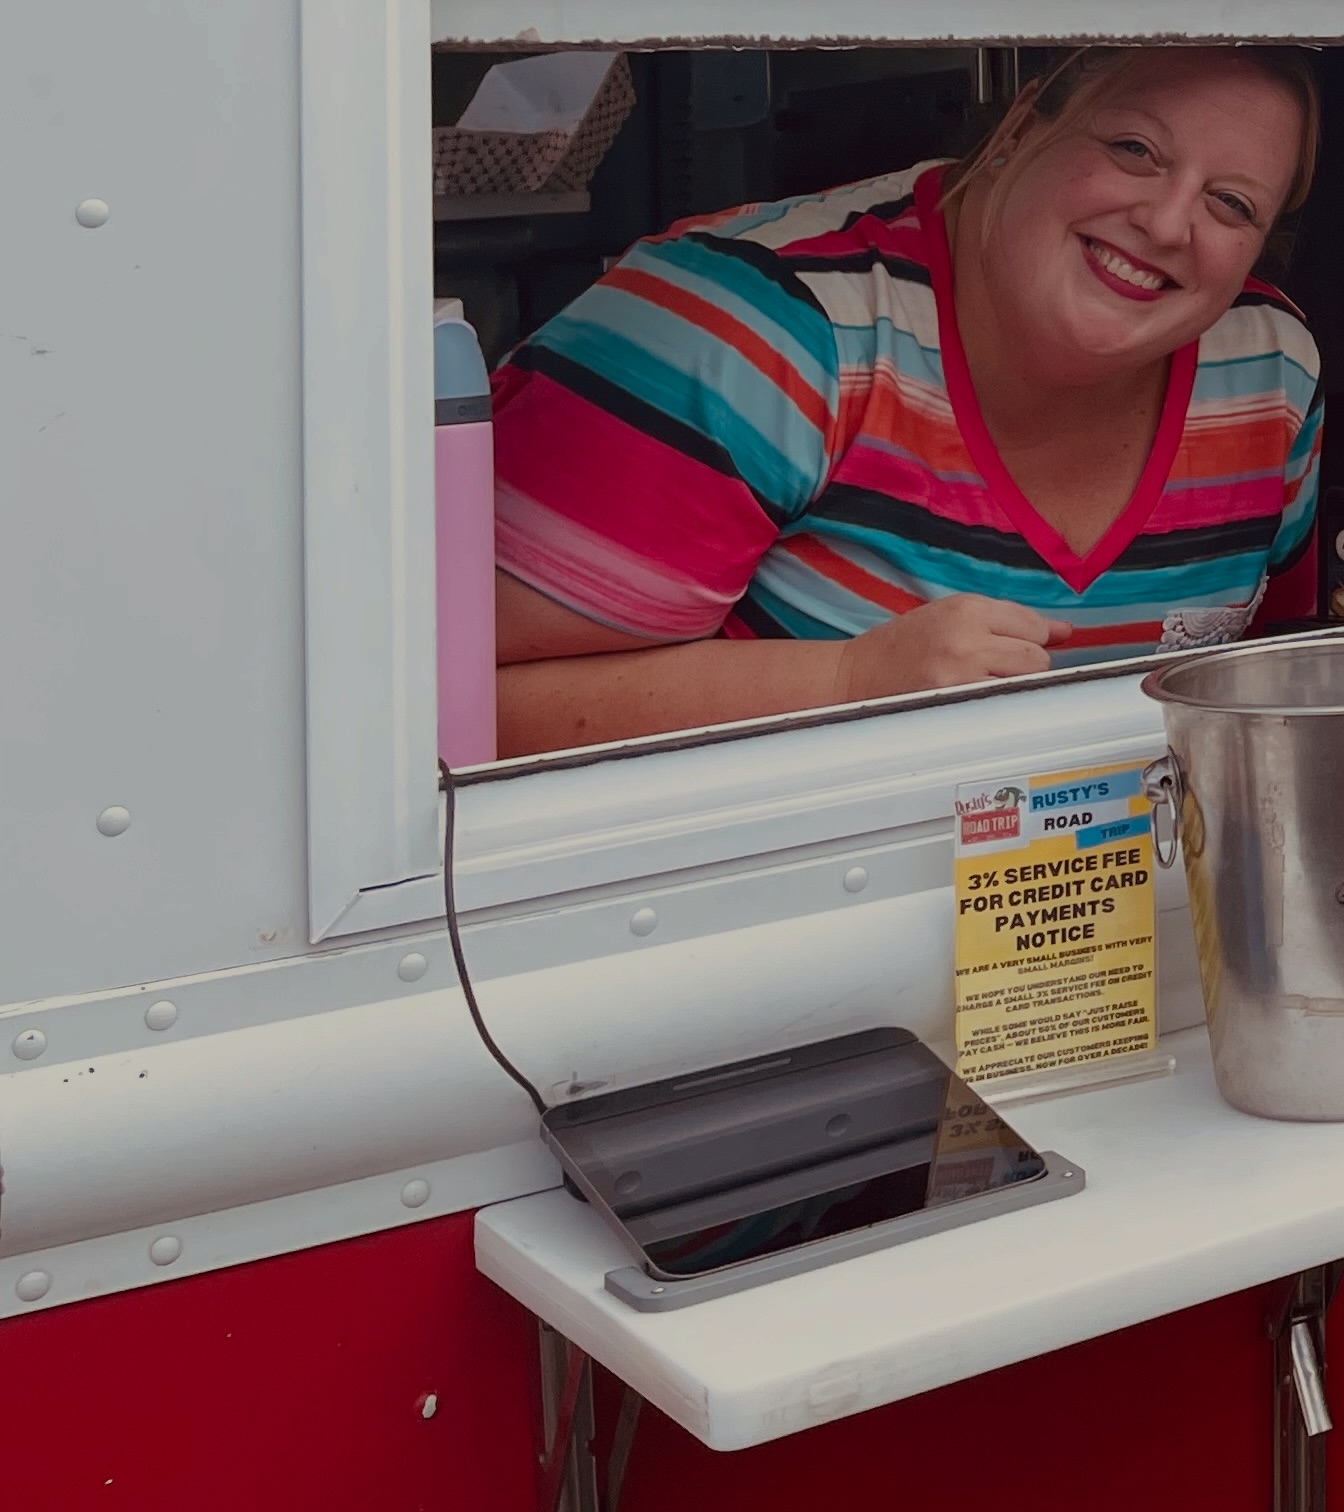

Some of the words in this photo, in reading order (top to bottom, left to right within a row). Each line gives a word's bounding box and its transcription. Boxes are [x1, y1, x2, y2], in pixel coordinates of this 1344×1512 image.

[1031, 781, 1110, 811] RUSTY'S
[967, 870, 1000, 891] 3%
[1003, 854, 1098, 885] SERVICE
[1101, 847, 1141, 870] FEE
